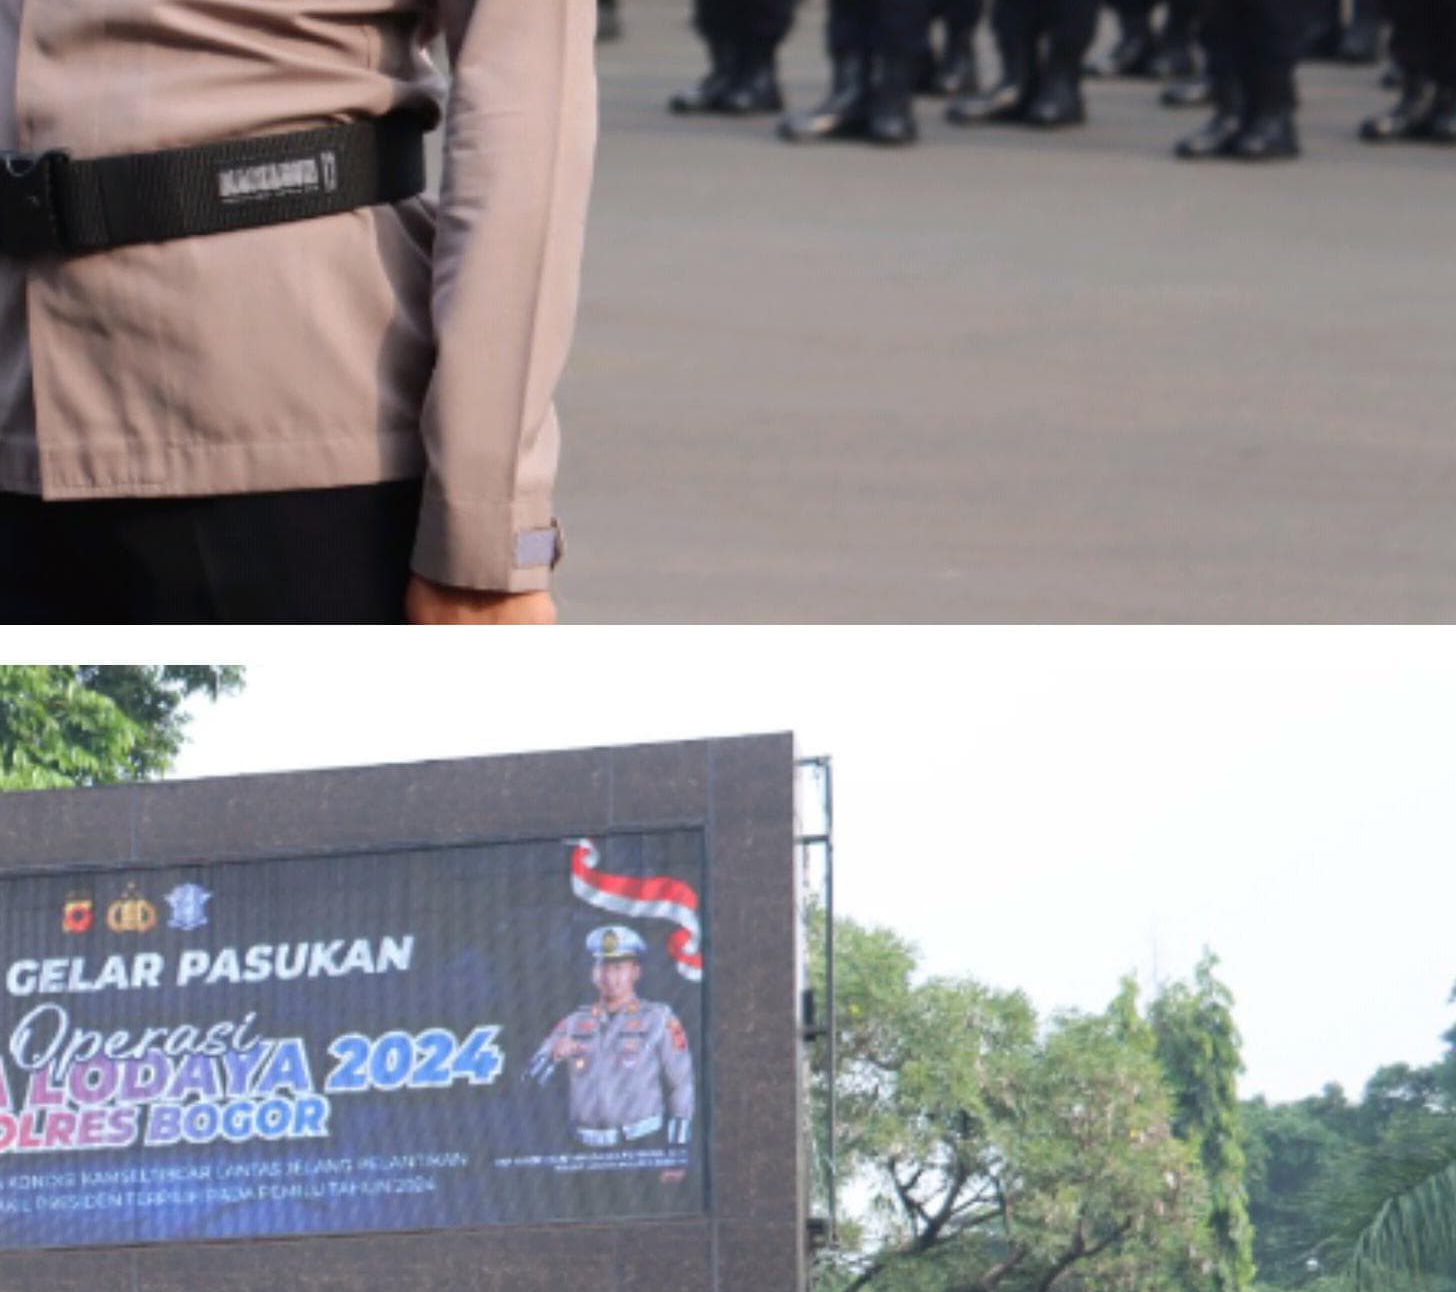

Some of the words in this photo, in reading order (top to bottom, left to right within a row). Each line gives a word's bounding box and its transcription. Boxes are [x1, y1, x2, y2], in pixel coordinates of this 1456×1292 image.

[6, 951, 164, 995] GELAR
[177, 935, 415, 986] PASUKAN
[9, 1003, 261, 1079] Operasi
[24, 1037, 315, 1108] LODAYA
[324, 1024, 505, 1094] 2024
[144, 1094, 330, 1146] BOGOR
